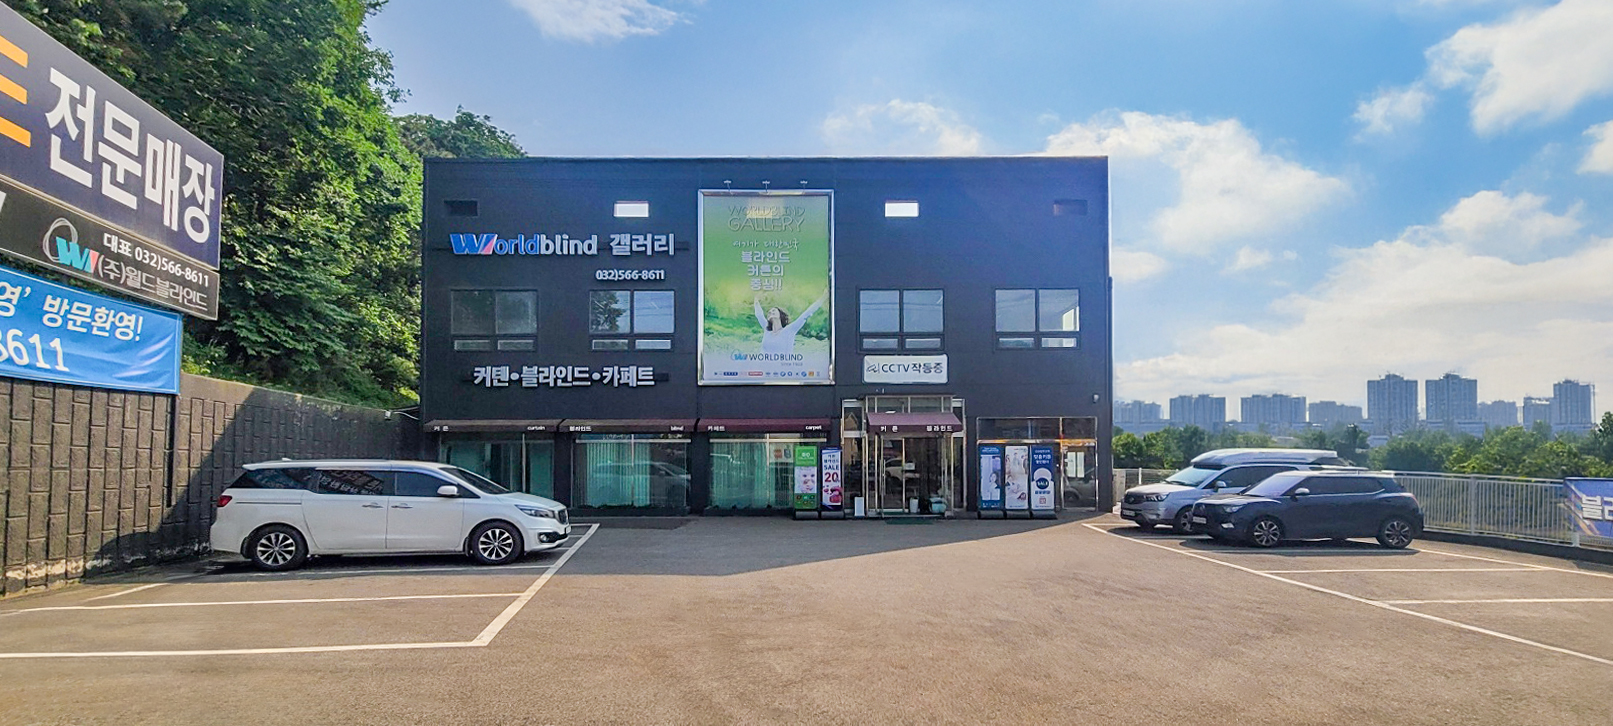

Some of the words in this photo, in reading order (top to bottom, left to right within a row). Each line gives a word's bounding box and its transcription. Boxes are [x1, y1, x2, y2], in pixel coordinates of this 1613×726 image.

[45, 67, 215, 243] 전문매장
[727, 216, 805, 232] GALLERY
[450, 234, 598, 255] Worldblind
[609, 233, 675, 256] 갤러리
[103, 233, 132, 257] 대표
[135, 246, 209, 287] 032)566-8611
[741, 251, 790, 262] 블라인드
[595, 269, 665, 282] 032)566-8611
[747, 264, 784, 277] 커튼의
[98, 255, 208, 311] (주)월드블라인드
[750, 278, 782, 291] 중심!!
[42, 294, 143, 342] 방문환영!
[749, 353, 803, 361] WORLDBLIND
